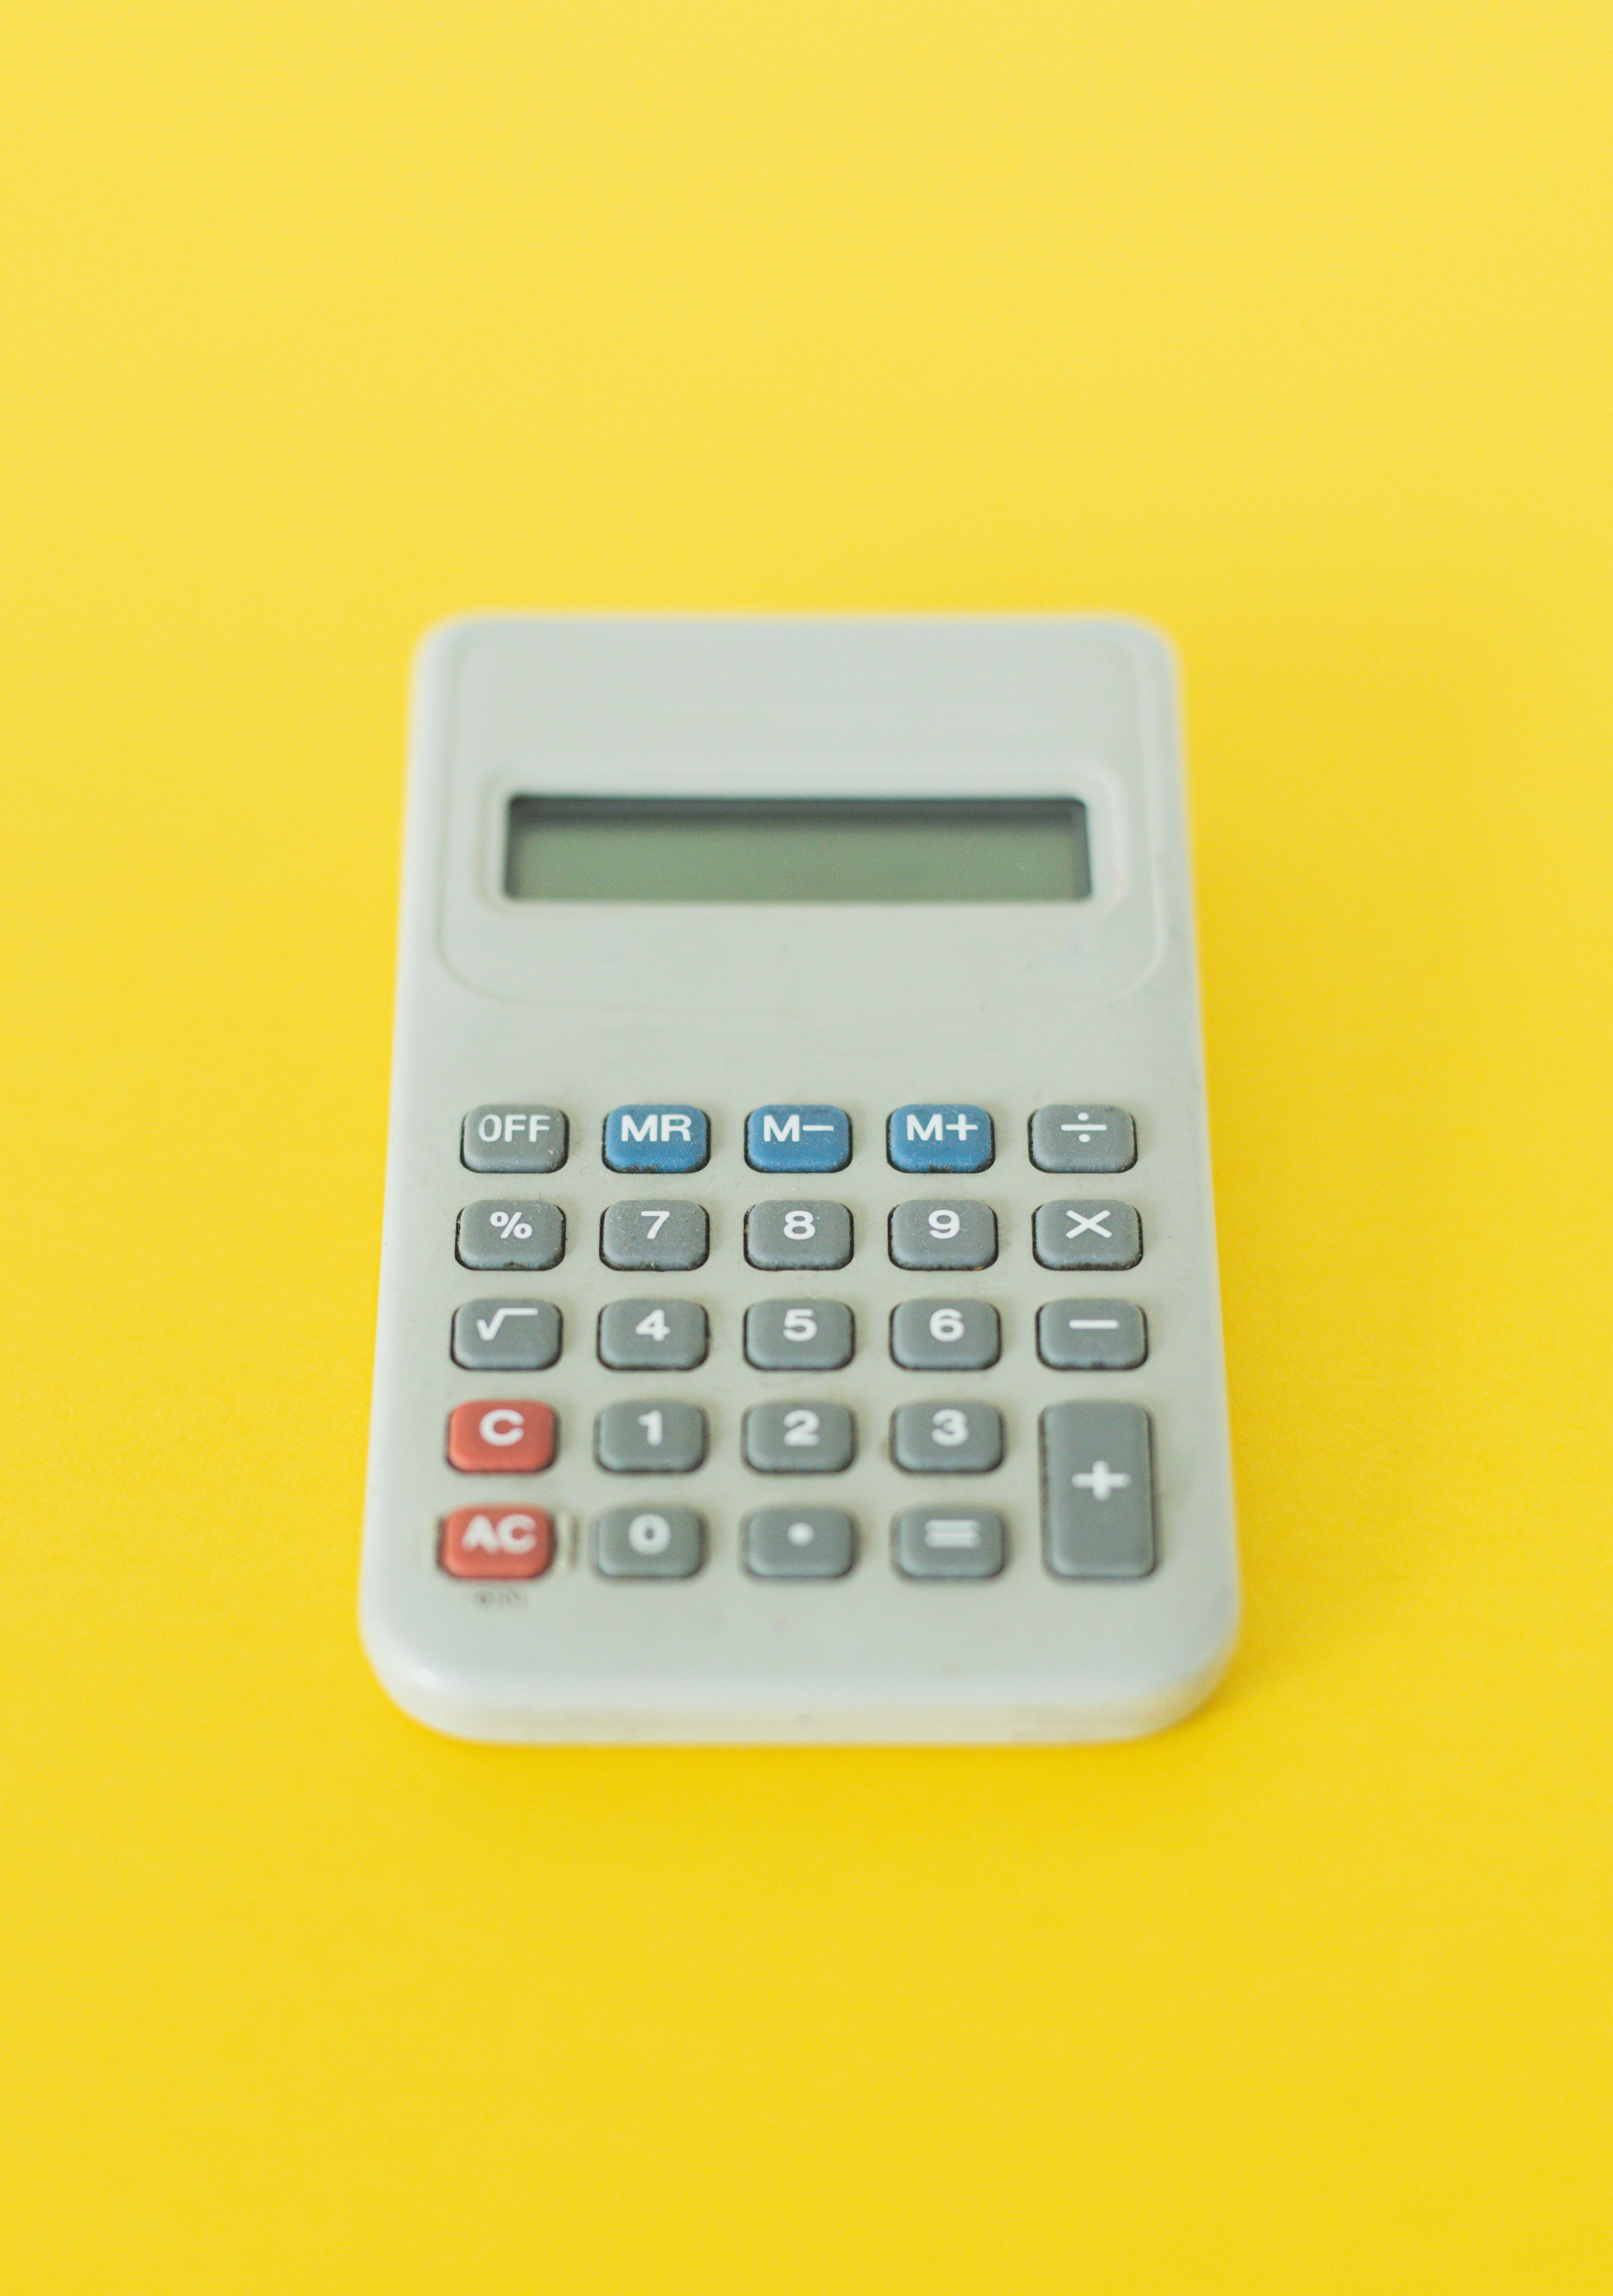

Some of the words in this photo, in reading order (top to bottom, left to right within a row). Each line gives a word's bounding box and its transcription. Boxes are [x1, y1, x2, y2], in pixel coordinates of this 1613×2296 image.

[478, 1114, 550, 1142] OFF
[621, 1113, 692, 1142] MR
[906, 1113, 978, 1141] M+
[489, 1211, 533, 1239] %
[640, 1209, 671, 1240] 7
[783, 1210, 816, 1240] 8
[928, 1209, 960, 1240] 9
[635, 1309, 669, 1341] 4
[784, 1308, 817, 1342] 5
[929, 1308, 964, 1342] 6
[479, 1409, 524, 1446] C
[640, 1410, 662, 1445] 1
[784, 1410, 819, 1445] 2
[932, 1409, 968, 1446] 3
[1073, 1461, 1128, 1499] +
[462, 1514, 534, 1553] AC
[628, 1514, 670, 1554] 0
